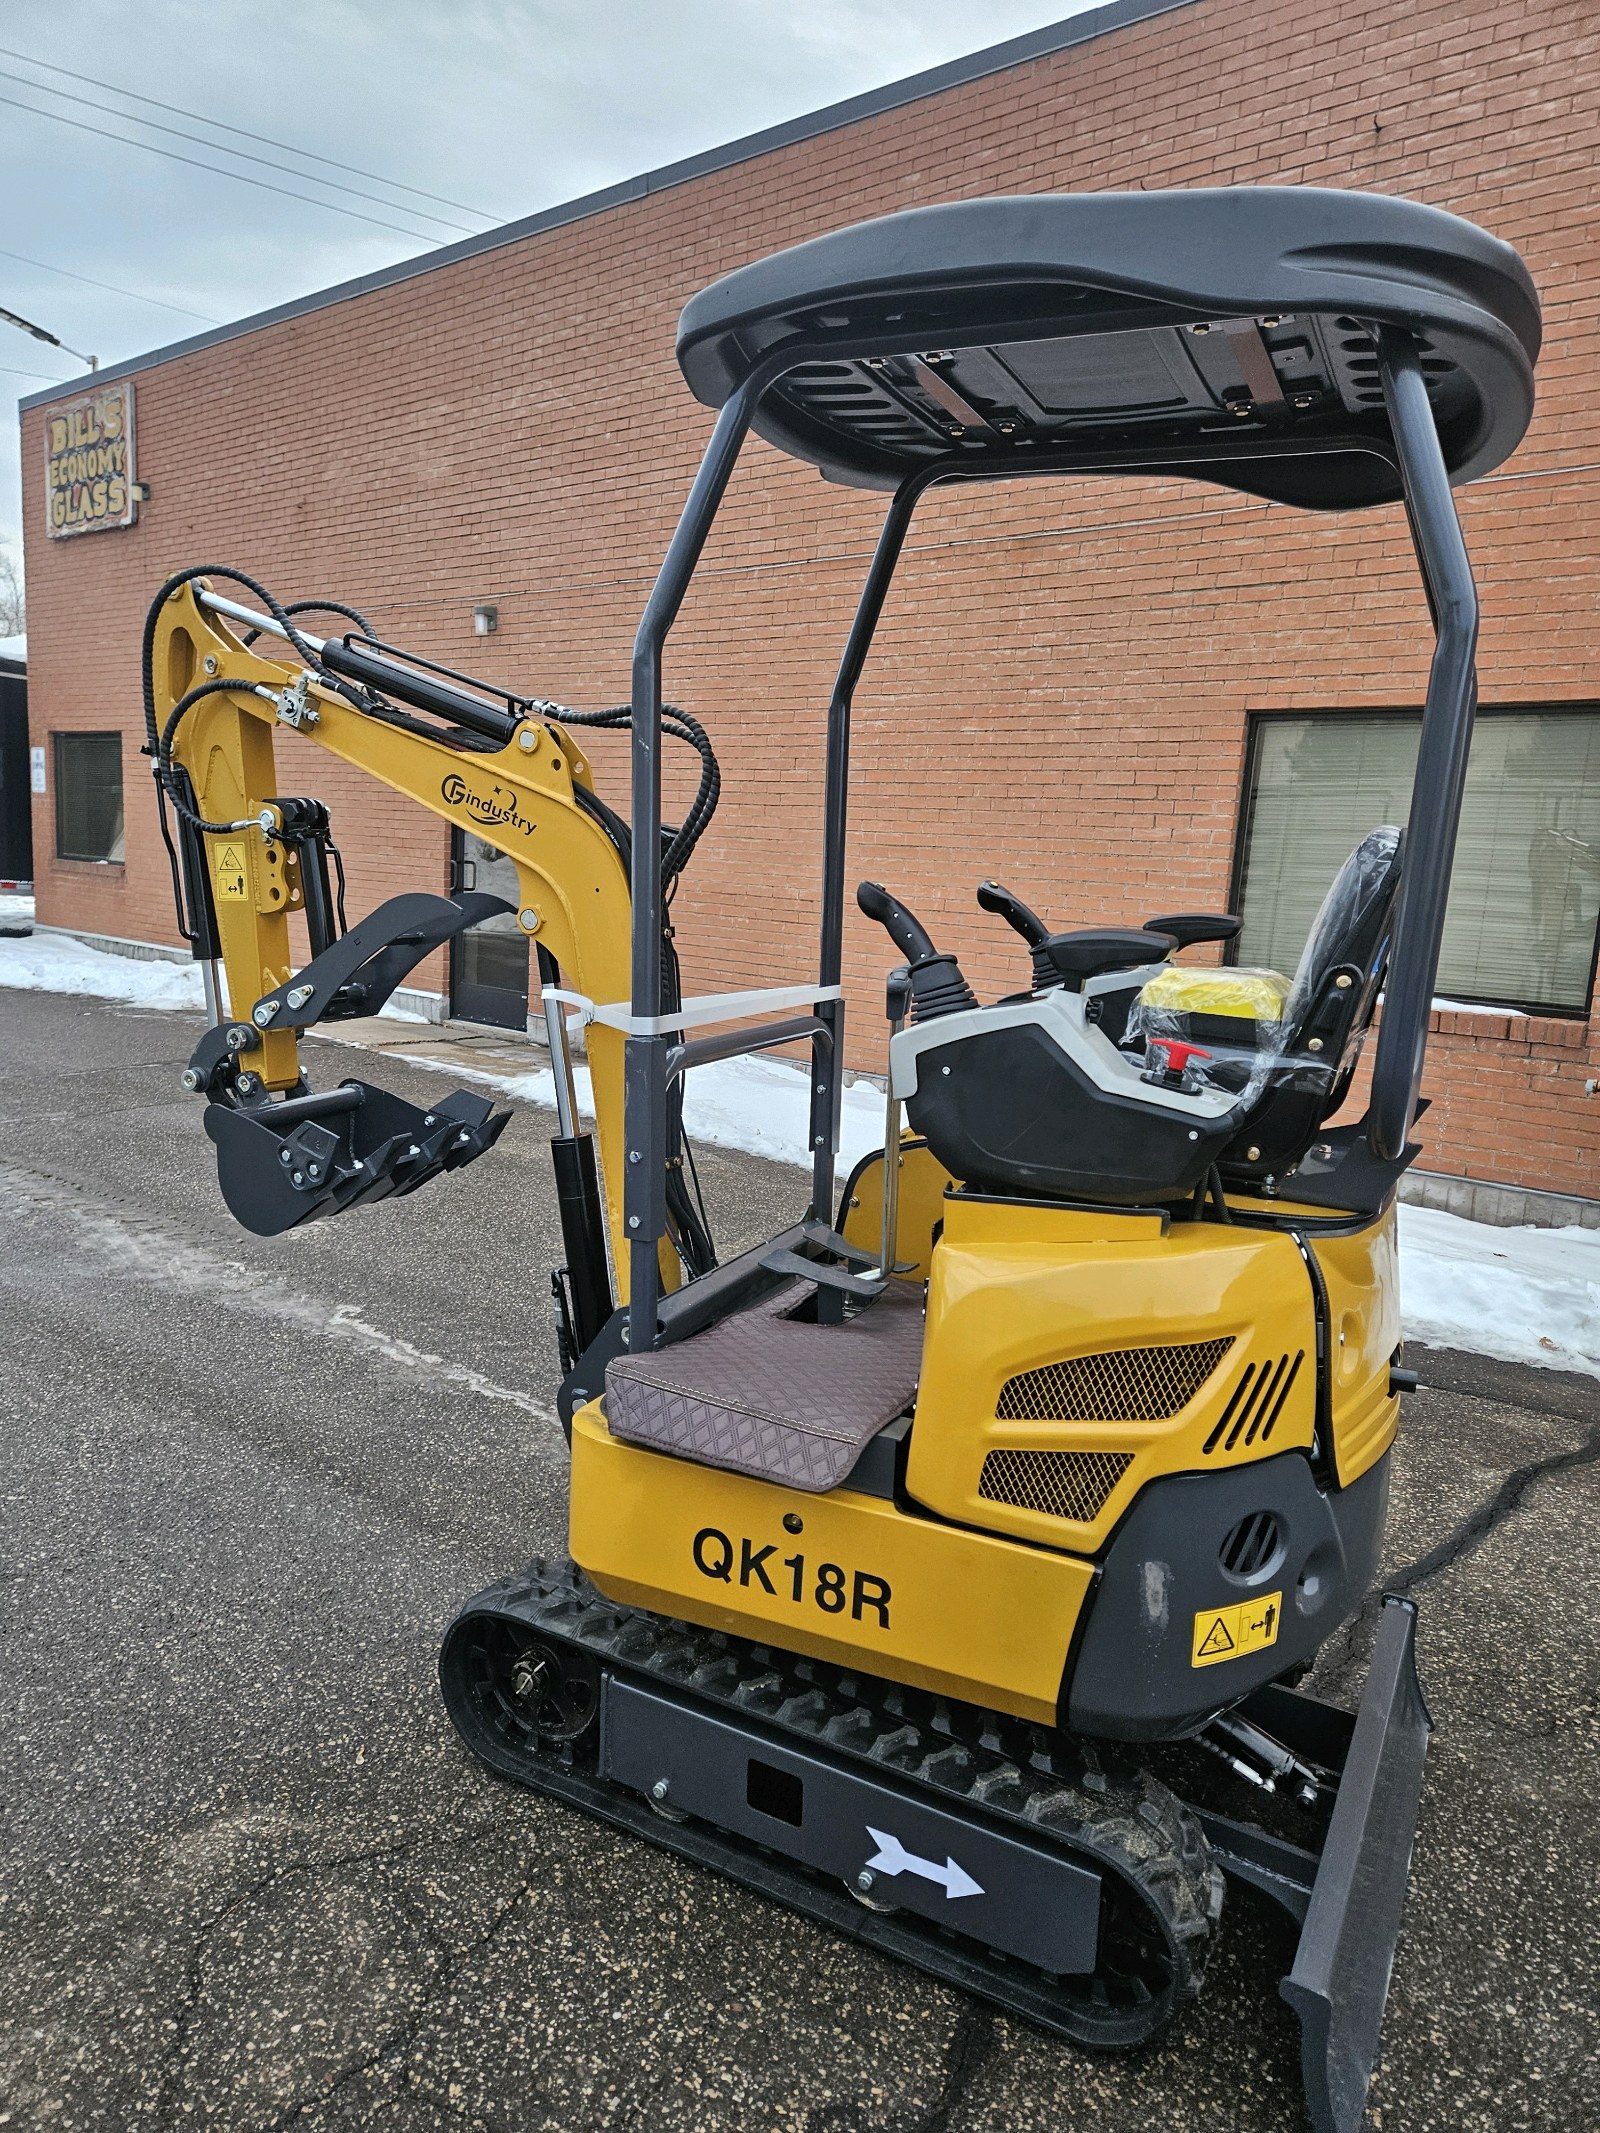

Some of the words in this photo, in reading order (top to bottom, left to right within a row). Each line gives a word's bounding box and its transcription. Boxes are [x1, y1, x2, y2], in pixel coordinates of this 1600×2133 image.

[51, 399, 122, 454] BILL'S
[50, 442, 125, 487] ECONOMY
[52, 479, 125, 527] GLASS
[692, 1527, 892, 1630] QK18R
